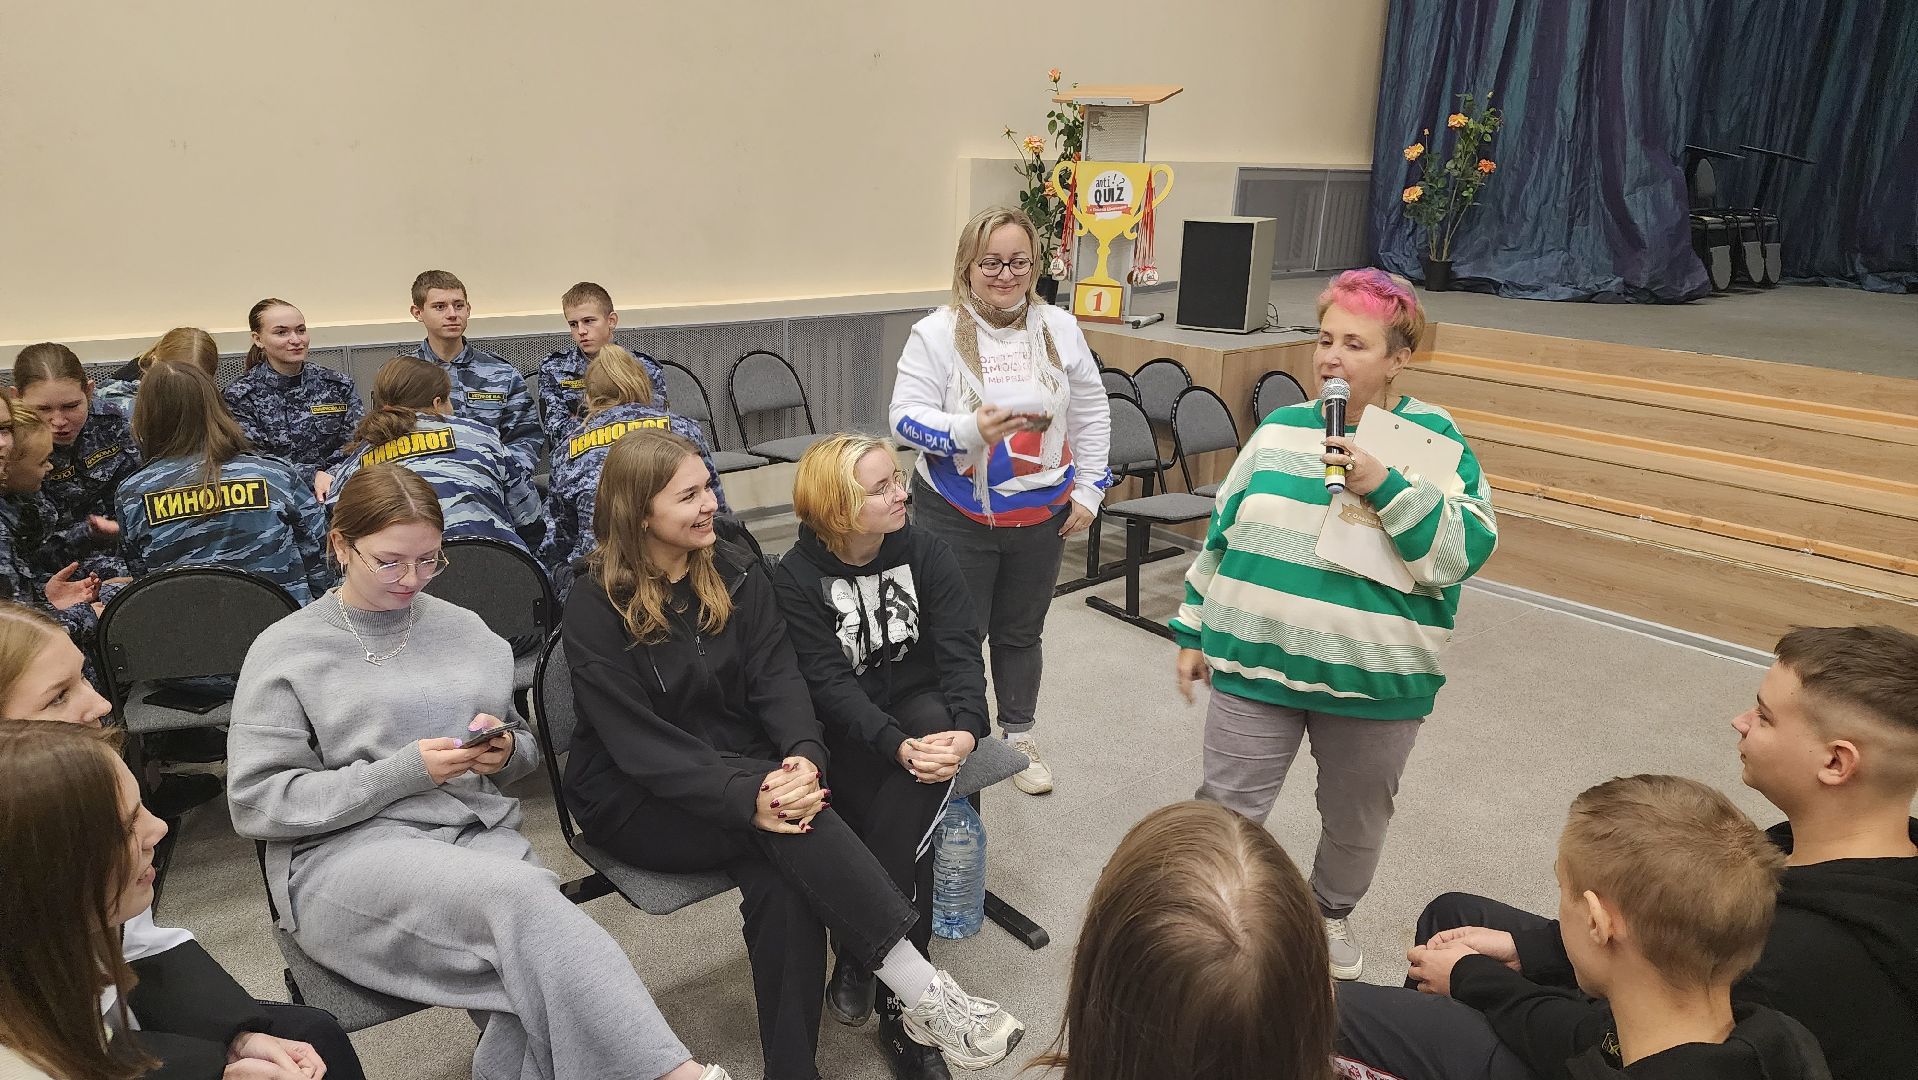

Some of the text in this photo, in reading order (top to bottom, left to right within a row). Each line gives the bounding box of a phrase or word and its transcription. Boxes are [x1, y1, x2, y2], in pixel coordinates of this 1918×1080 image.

[1095, 175, 1111, 188] anti
[1094, 187, 1125, 209] QUIZ
[1092, 291, 1103, 312] 1
[902, 421, 923, 441] МЫ
[362, 431, 449, 468] КИНОЛОГ
[153, 482, 260, 519] КИНОЛОГ
